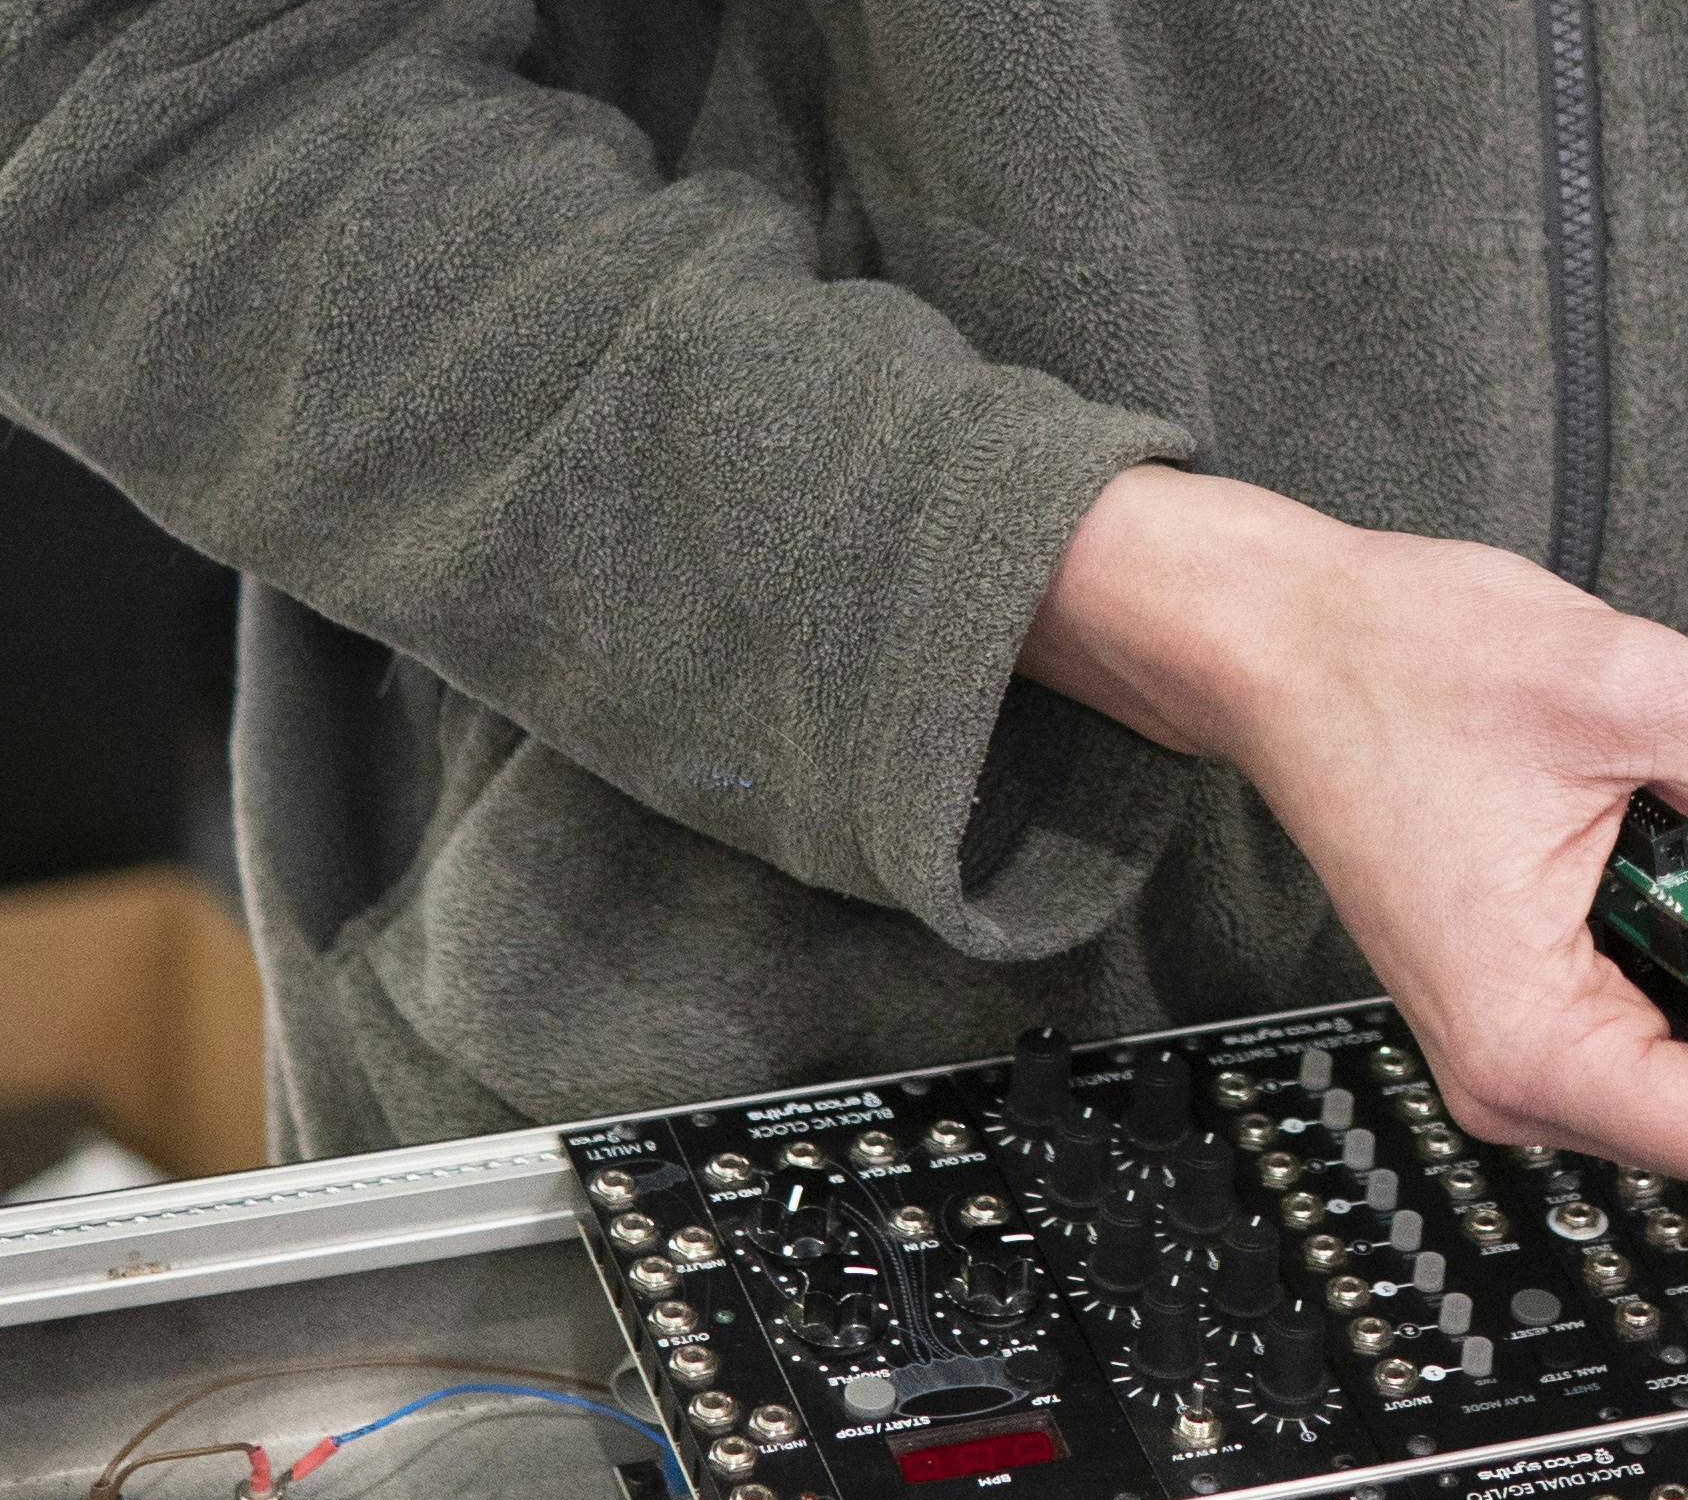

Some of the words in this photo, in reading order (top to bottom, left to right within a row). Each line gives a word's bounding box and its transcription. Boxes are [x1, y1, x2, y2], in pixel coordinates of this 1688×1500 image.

[816, 1099, 862, 1112] erica
[812, 1117, 834, 1129] VC
[837, 1107, 895, 1126] BLACK
[748, 1120, 809, 1138] CLOCK
[585, 1142, 641, 1160] MULTI
[960, 1152, 986, 1164] CLK
[929, 1157, 958, 1168] OUT
[1539, 1371, 1572, 1383] STEP
[1031, 1393, 1061, 1406] TAP
[1383, 1395, 1432, 1412] IN/OUT
[1502, 1394, 1536, 1406] PLAY
[885, 1416, 930, 1432] START
[836, 1425, 874, 1439] STOP
[1543, 1452, 1594, 1470] erica
[1477, 1461, 1542, 1481] synths
[1588, 1463, 1645, 1482] BLACK
[978, 1473, 1011, 1487] BPM
[1534, 1473, 1586, 1490] DUAL
